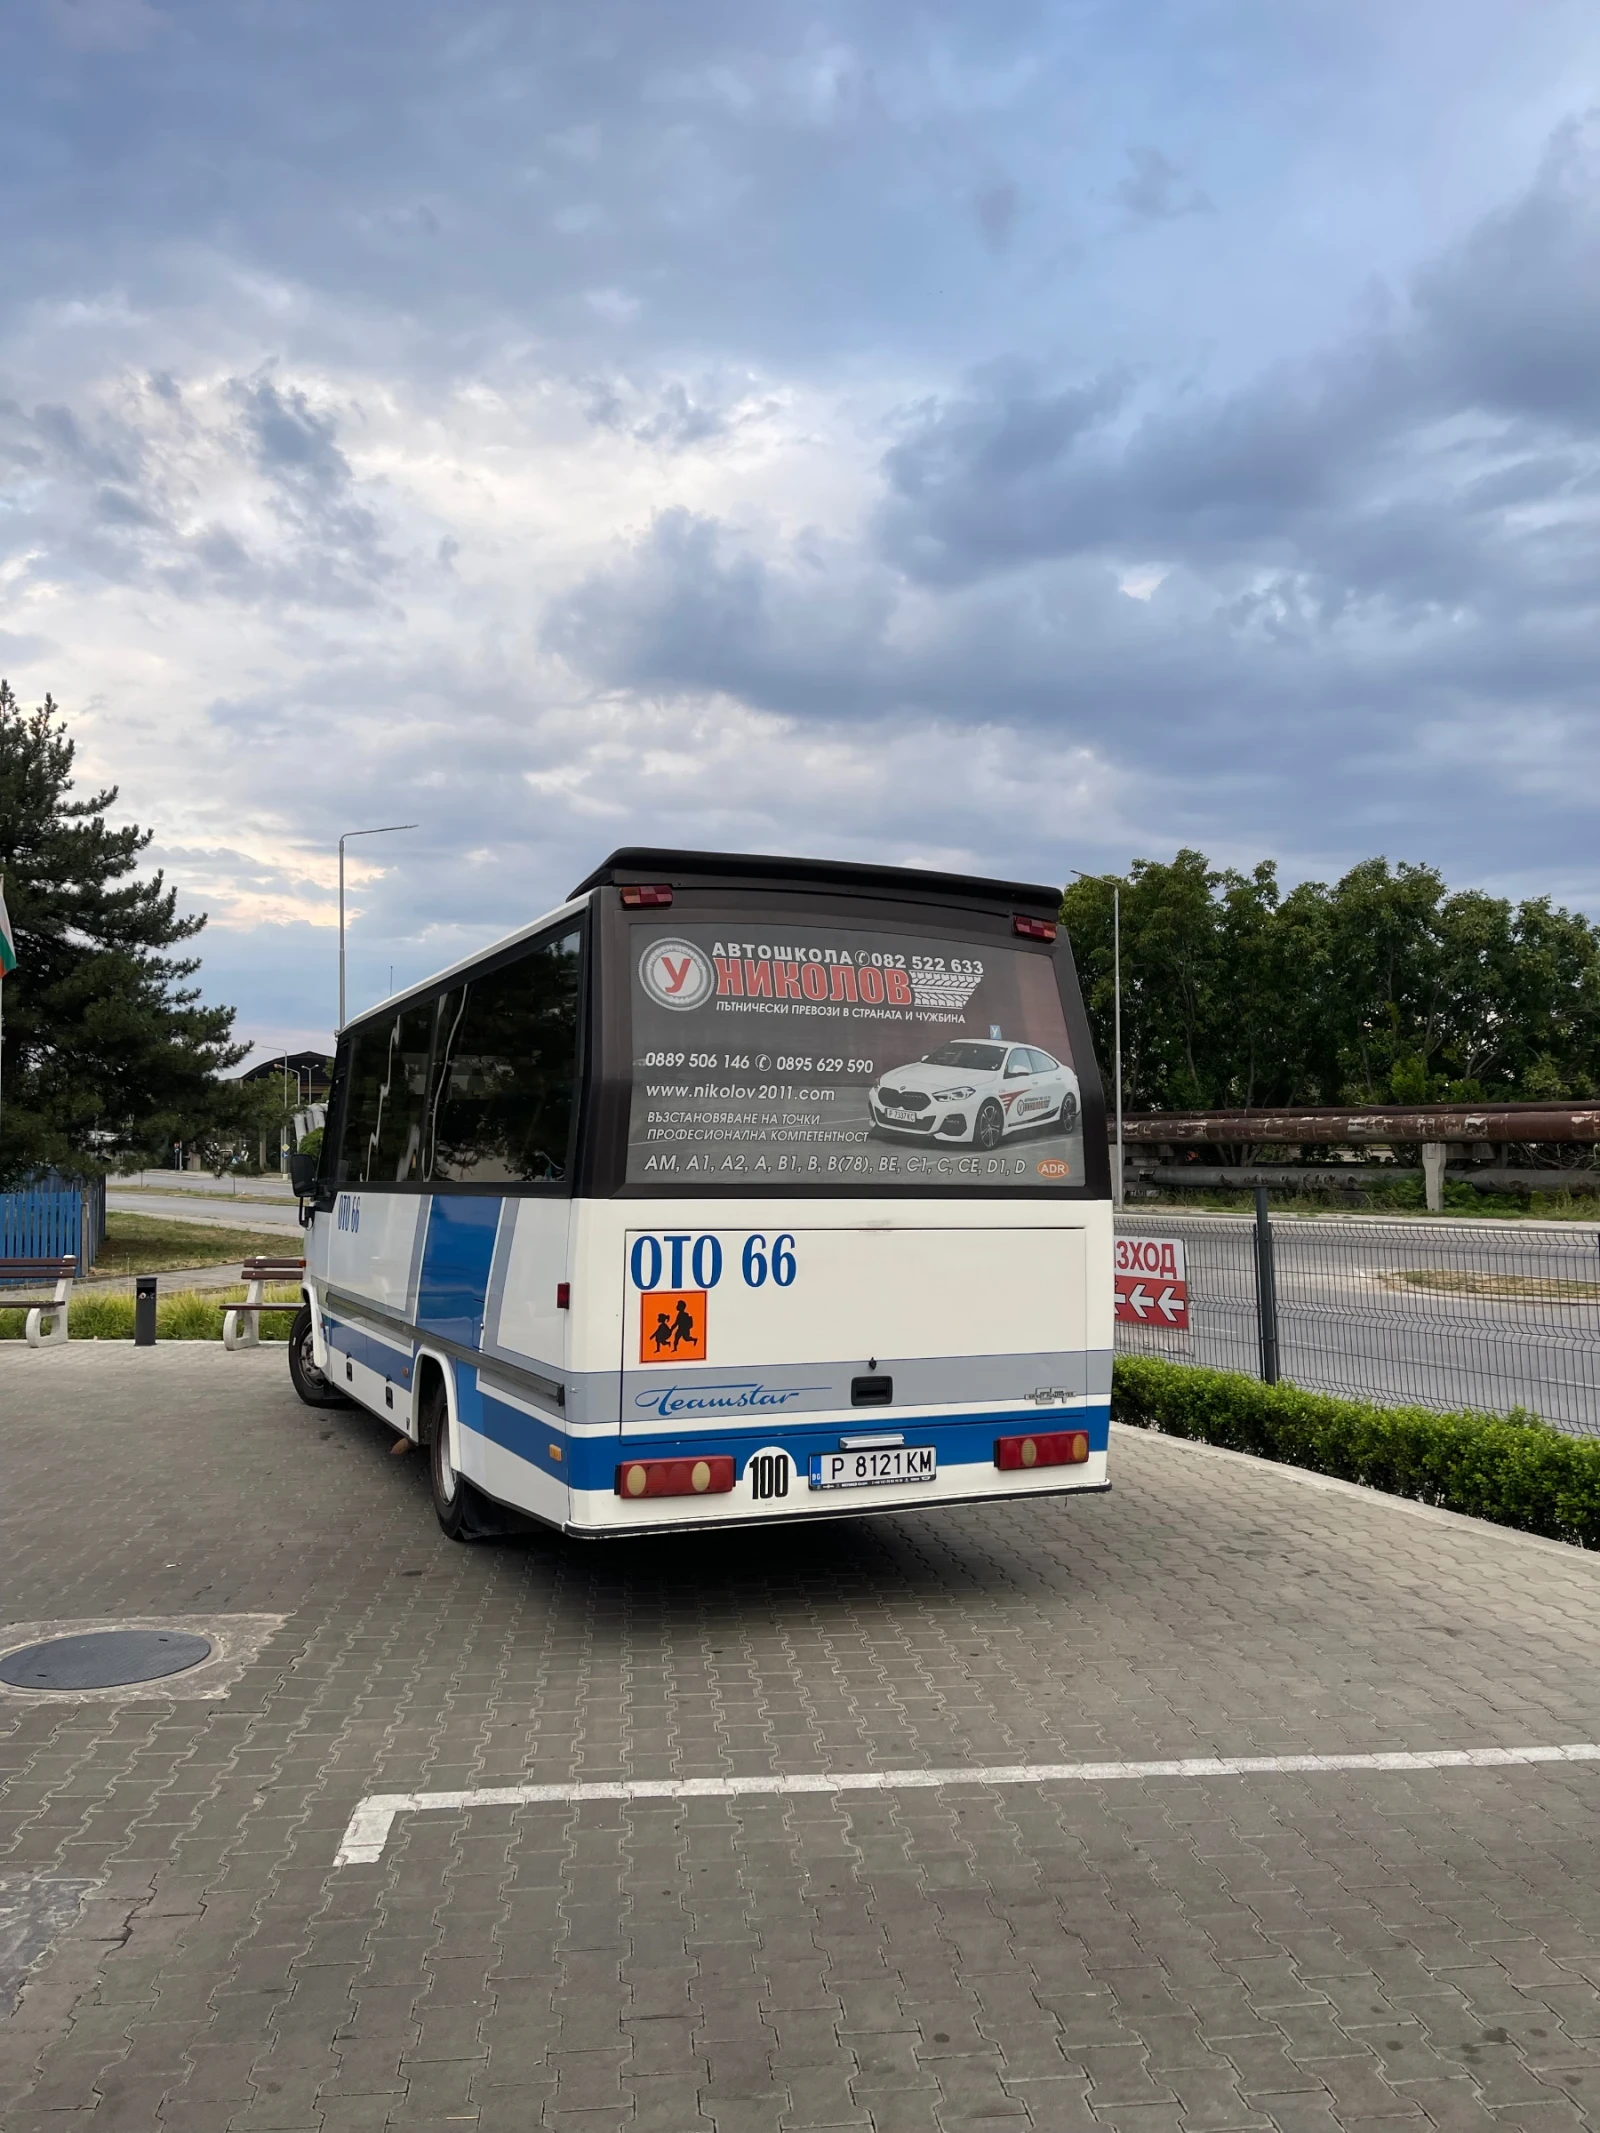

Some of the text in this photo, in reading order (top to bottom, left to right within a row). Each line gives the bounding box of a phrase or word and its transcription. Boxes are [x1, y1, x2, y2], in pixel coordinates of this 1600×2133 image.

[712, 942, 984, 975] АВТОШКОЛА 082 522 633
[660, 957, 692, 994] У
[713, 957, 912, 1005] НИКОЛОВ
[716, 1001, 966, 1024] ПЪТНИЧЕСКИ ПРЕВОЗИ В СТРАНАТА И ЧУЖБИНА
[645, 1052, 874, 1074] 0889 506 146 0895 629 590
[646, 1083, 836, 1101] www.nikolov2011.com
[647, 1111, 821, 1125] ВЪЗСТАНОВЯВАНЕ НА ТОЧКИ
[647, 1128, 870, 1142] ПРОФЕСИОНАЛНА КОМПЕТЕНТНОСТ
[827, 1156, 873, 1174] B(78),
[1014, 1160, 1027, 1174] D
[1040, 1163, 1066, 1174] ADR
[351, 1196, 360, 1233] 66
[741, 1234, 797, 1288] 66
[1114, 1240, 1178, 1279] ЗХОД
[635, 1384, 832, 1416] Teamstar
[749, 1455, 789, 1500] 100
[811, 1473, 821, 1481] BG
[832, 1457, 845, 1480] P
